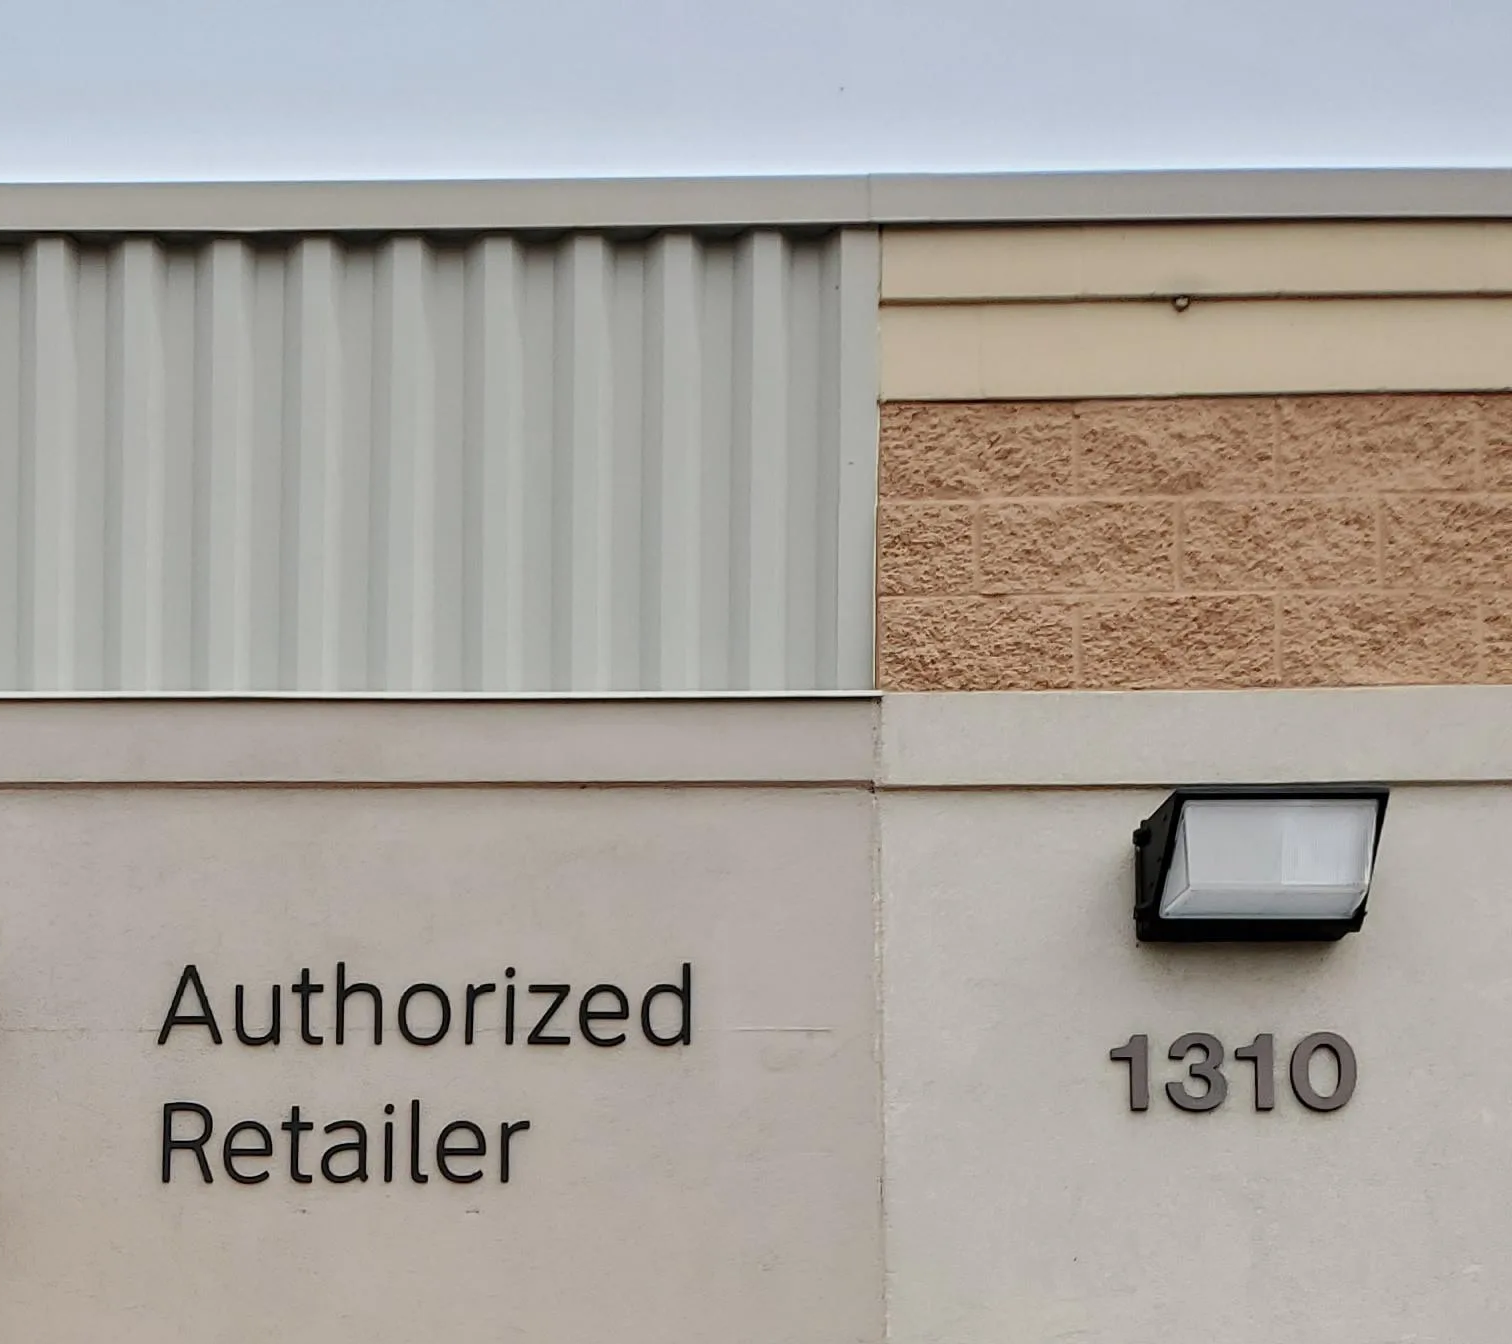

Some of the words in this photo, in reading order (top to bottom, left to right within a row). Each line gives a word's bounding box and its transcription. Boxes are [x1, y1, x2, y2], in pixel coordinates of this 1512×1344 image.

[157, 961, 692, 1047] Authorized
[1109, 1031, 1357, 1113] 1310
[161, 1099, 531, 1184] Retailer
